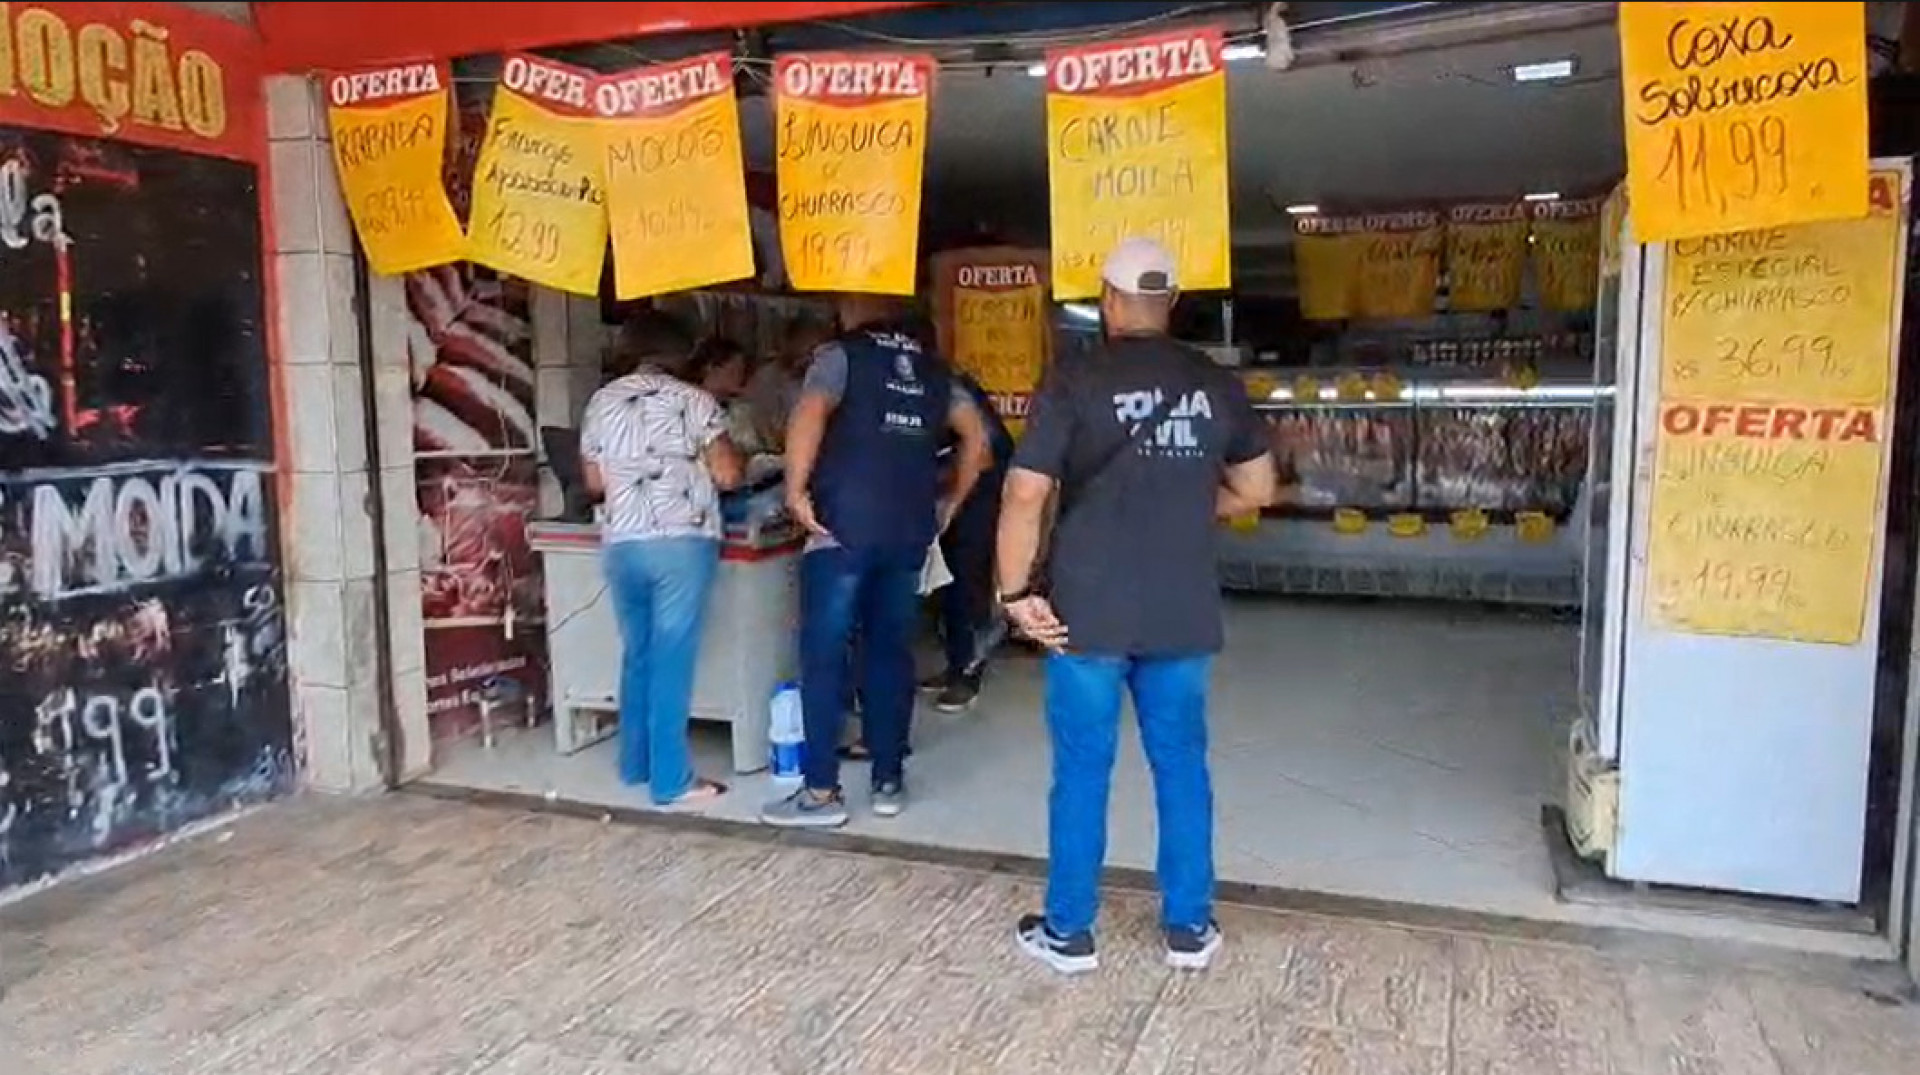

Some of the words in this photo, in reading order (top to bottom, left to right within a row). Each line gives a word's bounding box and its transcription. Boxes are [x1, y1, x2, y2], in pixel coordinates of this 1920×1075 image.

[1667, 16, 1793, 70] Coxa
[332, 64, 440, 106] OFERTA
[785, 62, 919, 96] OFERTA
[1056, 38, 1214, 91] OFERTA
[596, 62, 722, 116] OFERTA
[1060, 101, 1185, 162] CARNE
[779, 190, 906, 220] CHURRASCO
[957, 265, 1038, 287] OFERTA
[1691, 255, 1841, 285] ESPECIAL
[1663, 404, 1878, 442] OFERTA
[31, 471, 267, 593] MOIDA
